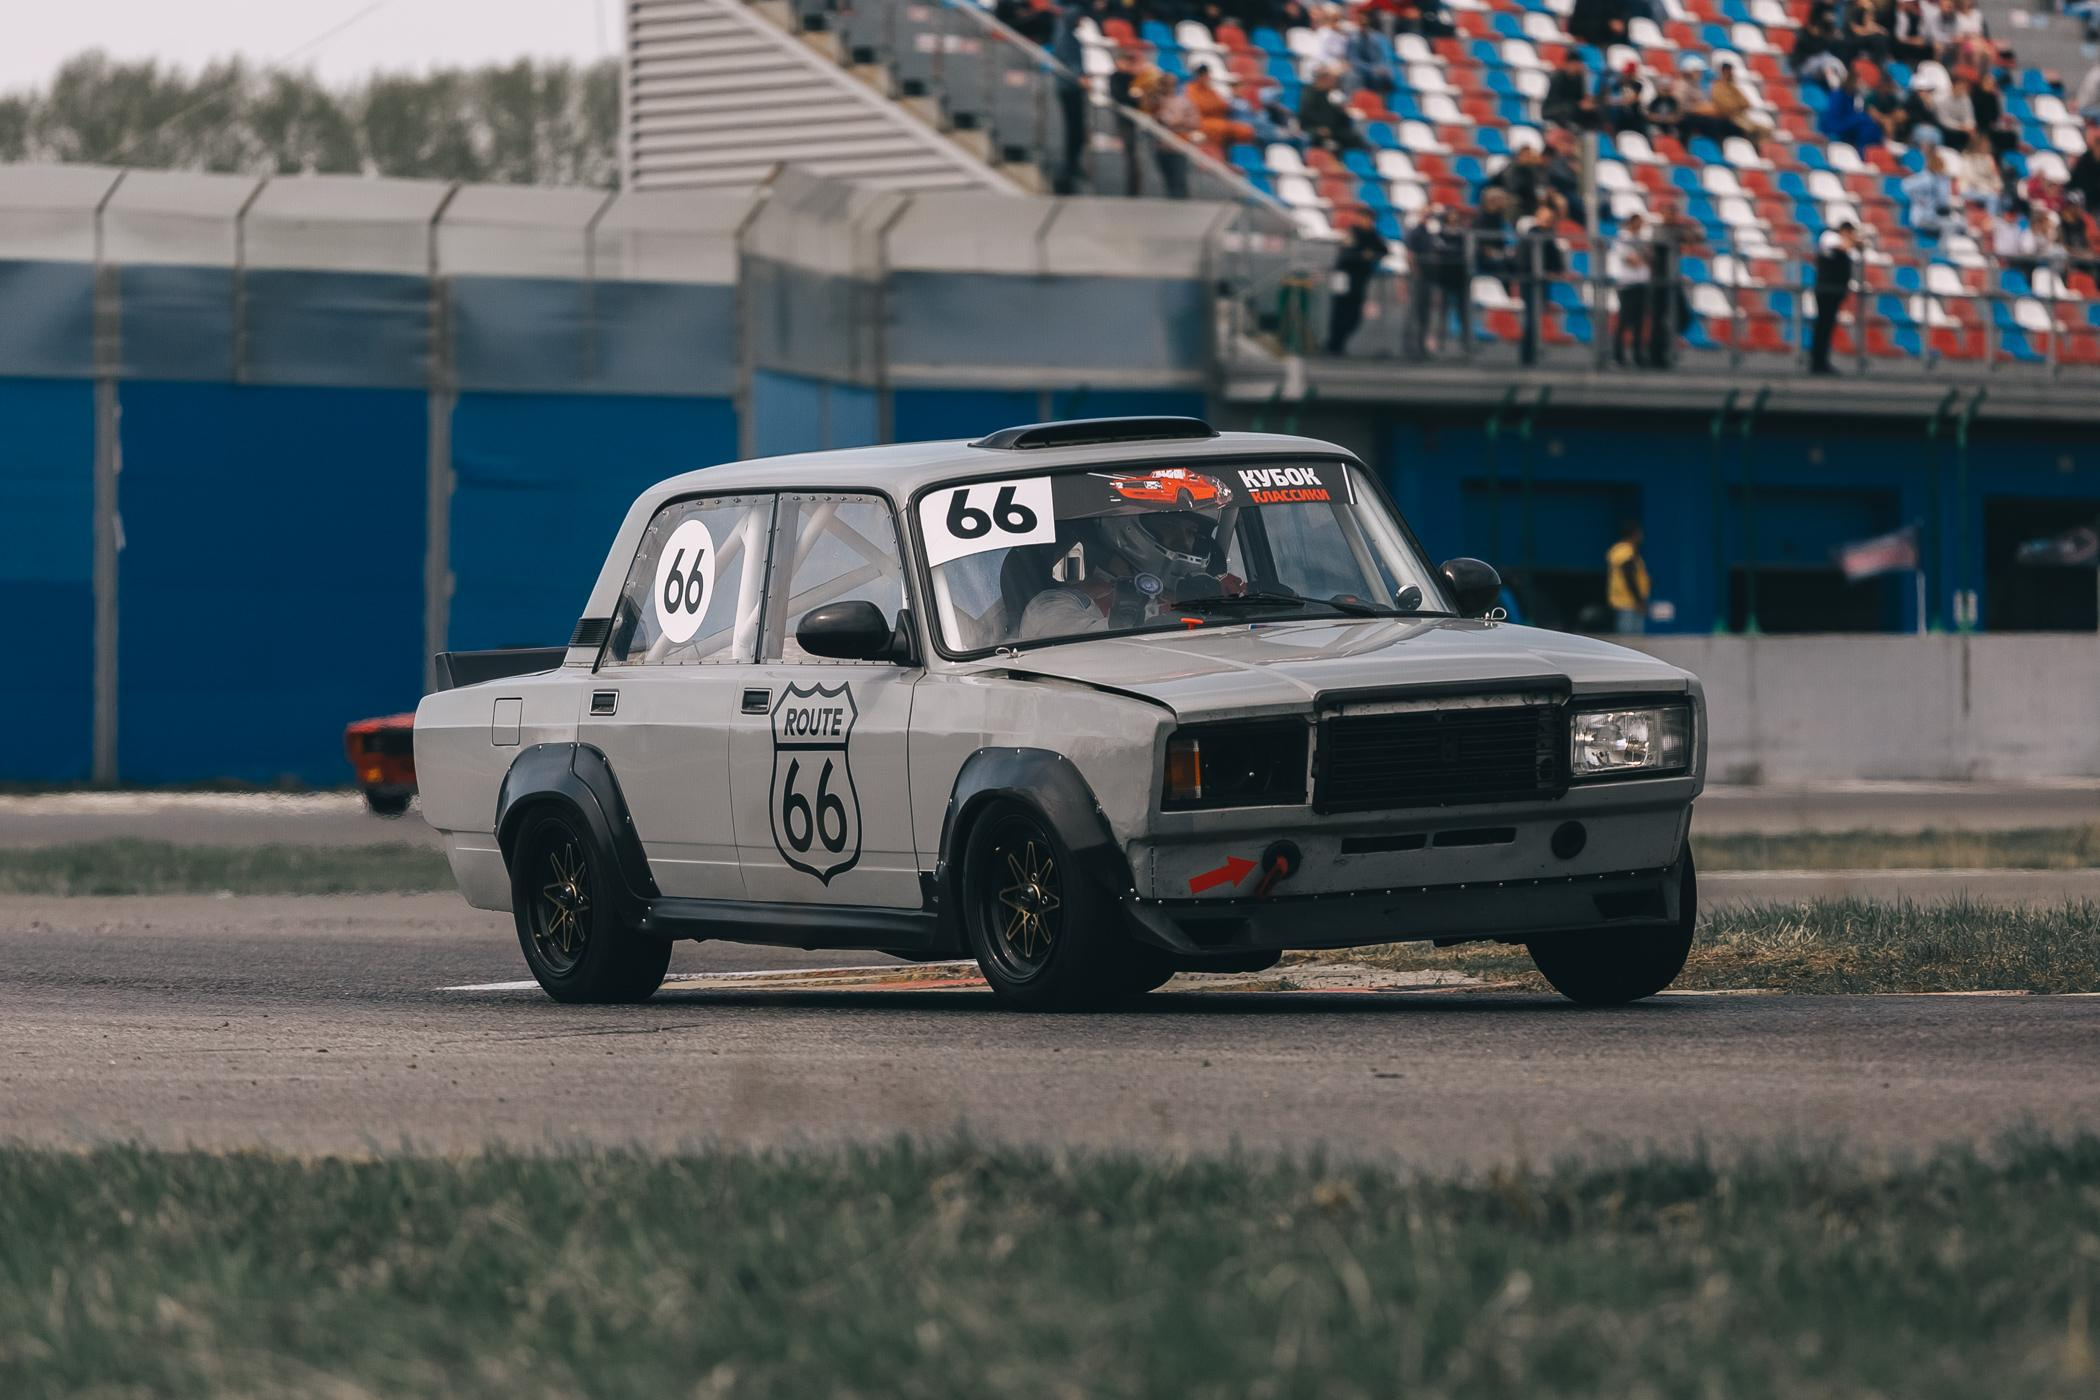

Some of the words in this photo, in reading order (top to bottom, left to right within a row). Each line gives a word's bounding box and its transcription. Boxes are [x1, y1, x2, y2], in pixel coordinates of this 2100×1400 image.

[1238, 467, 1322, 488] КУБОК
[1251, 488, 1331, 503] КЛАССИКИ
[946, 486, 1038, 539] 66
[664, 548, 705, 614] 66
[784, 708, 844, 737] ROUTE
[783, 757, 847, 853] 66
